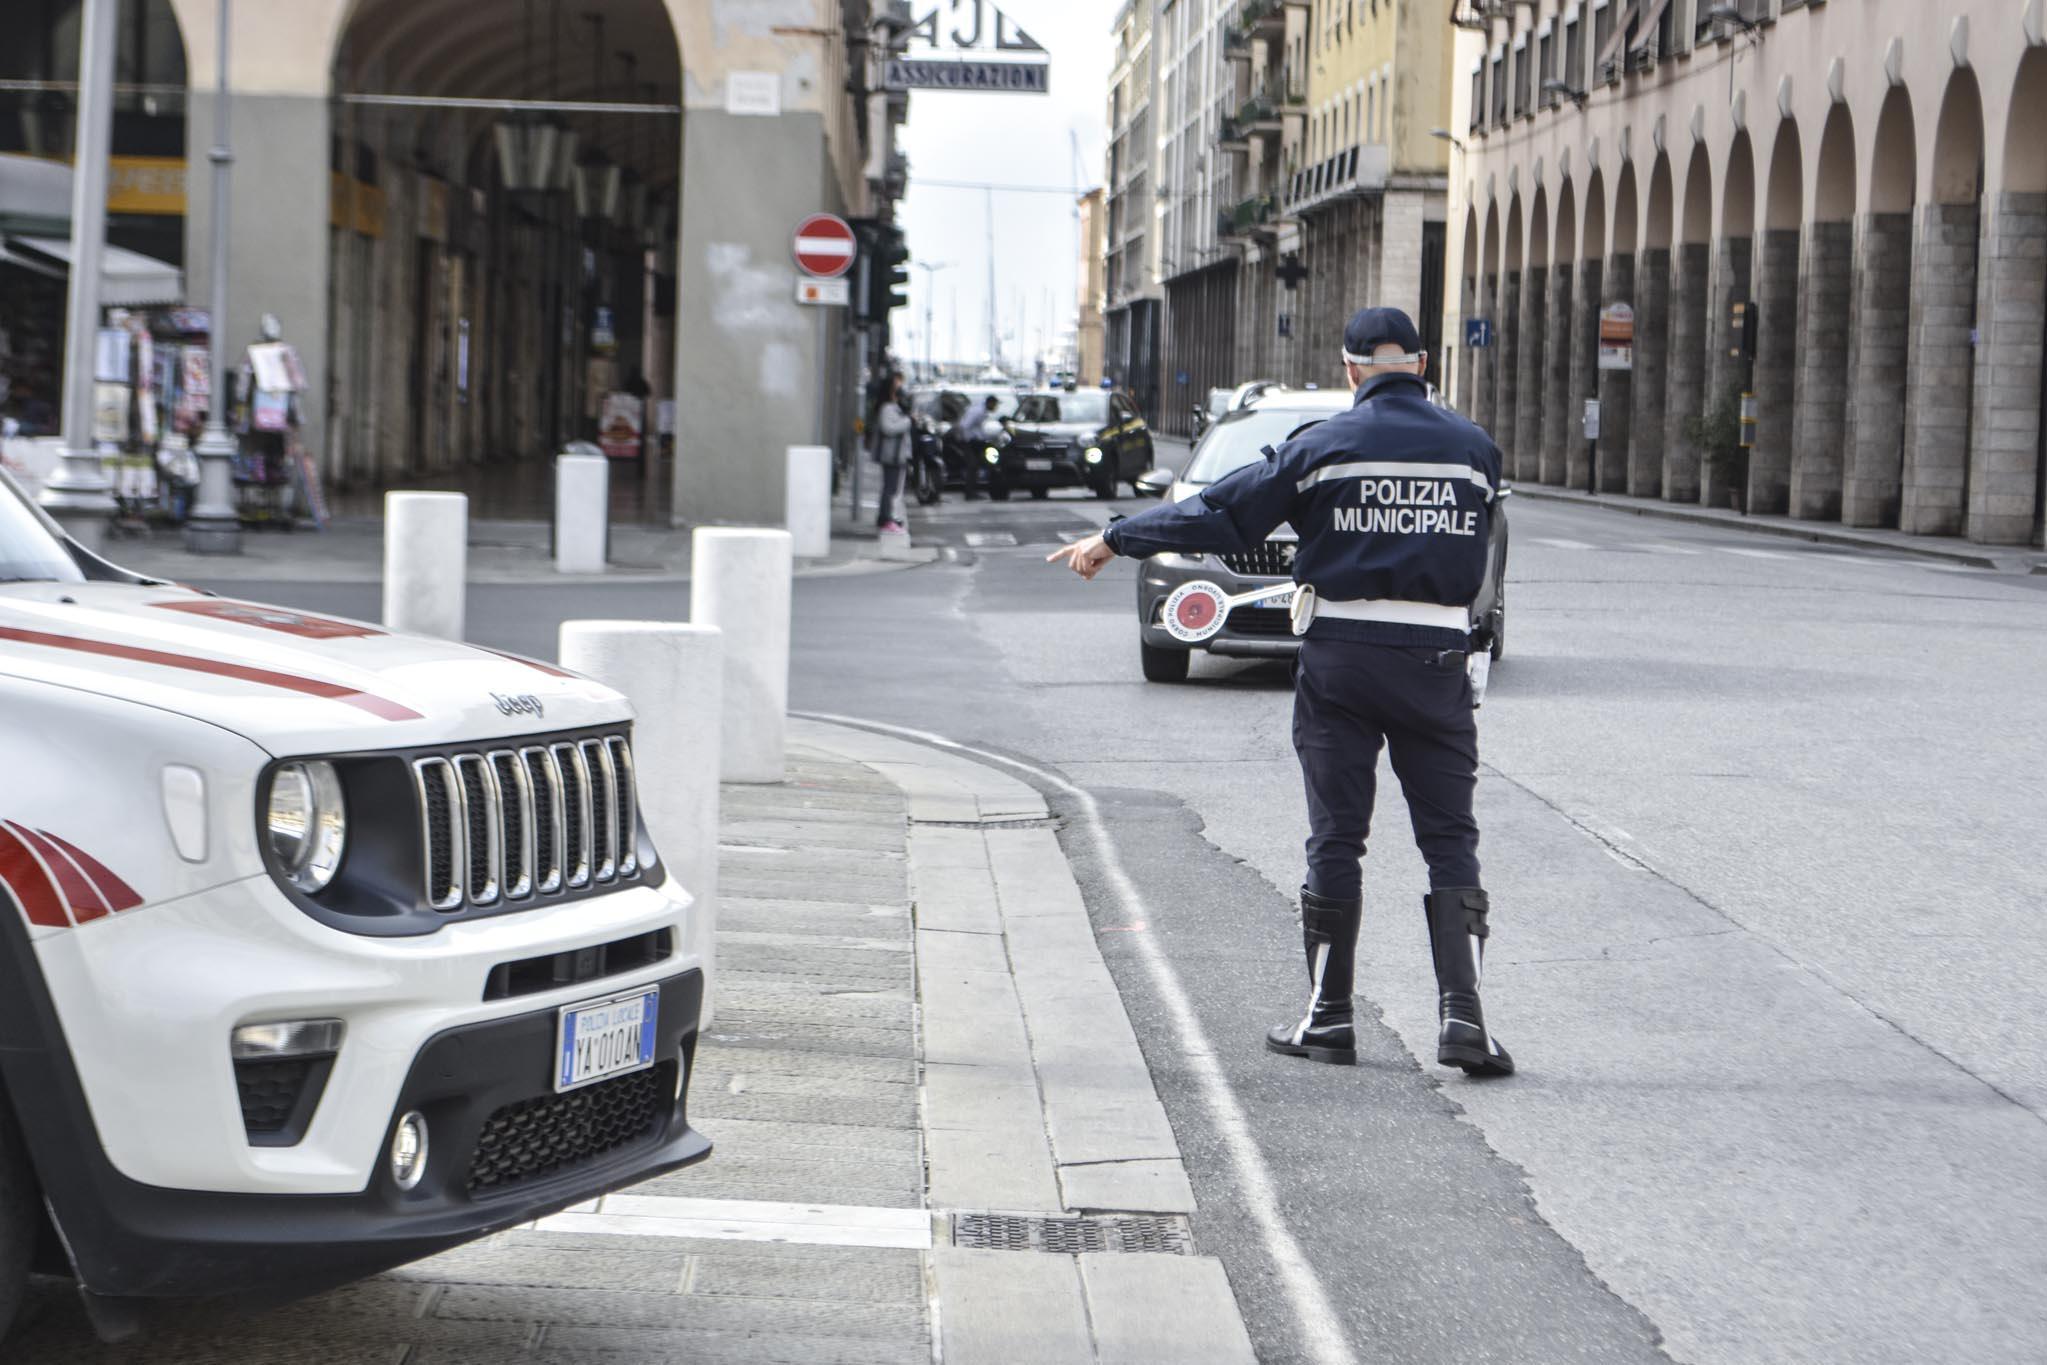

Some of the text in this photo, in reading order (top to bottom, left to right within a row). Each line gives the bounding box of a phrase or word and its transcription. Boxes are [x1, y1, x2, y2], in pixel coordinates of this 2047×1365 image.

[889, 64, 1046, 89] ASSICURAZIONI
[1360, 479, 1457, 506] POLIZIA
[1334, 507, 1478, 536] MUNICIPALE
[1168, 591, 1184, 616] POLIZIA
[489, 691, 544, 719] Jeep
